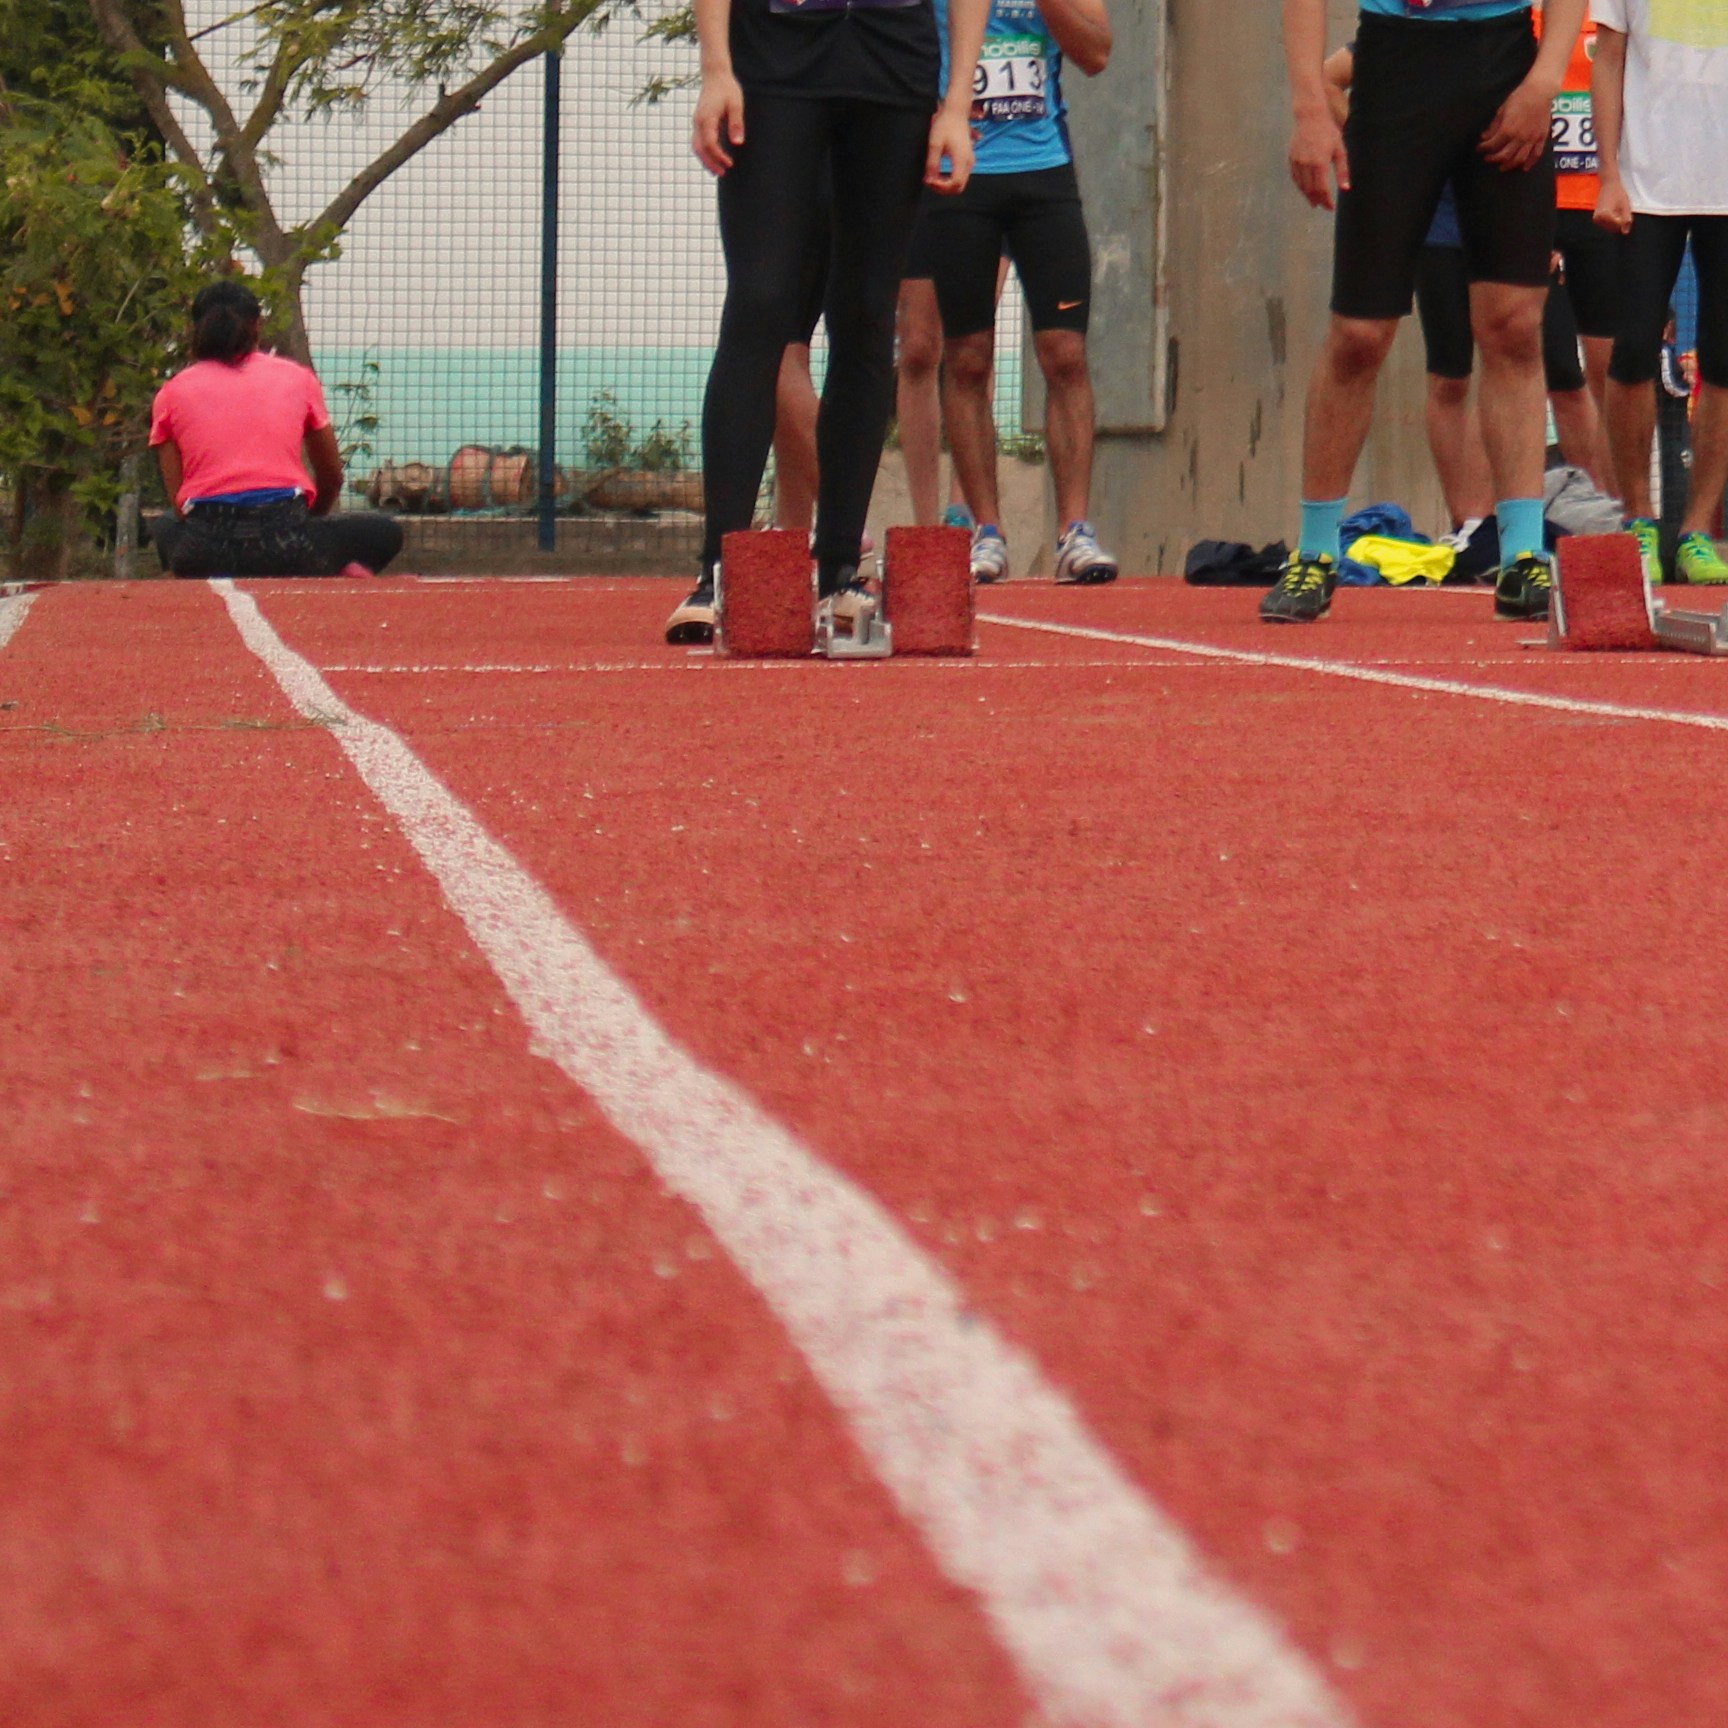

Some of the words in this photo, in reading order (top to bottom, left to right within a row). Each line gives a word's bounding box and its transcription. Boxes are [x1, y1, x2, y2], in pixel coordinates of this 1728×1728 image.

[973, 60, 1042, 95] 913
[991, 102, 1010, 115] FAA
[1011, 101, 1032, 114] ONE
[1551, 97, 1592, 113] bilis
[1560, 157, 1579, 169] ONE
[1585, 157, 1598, 169] DA
